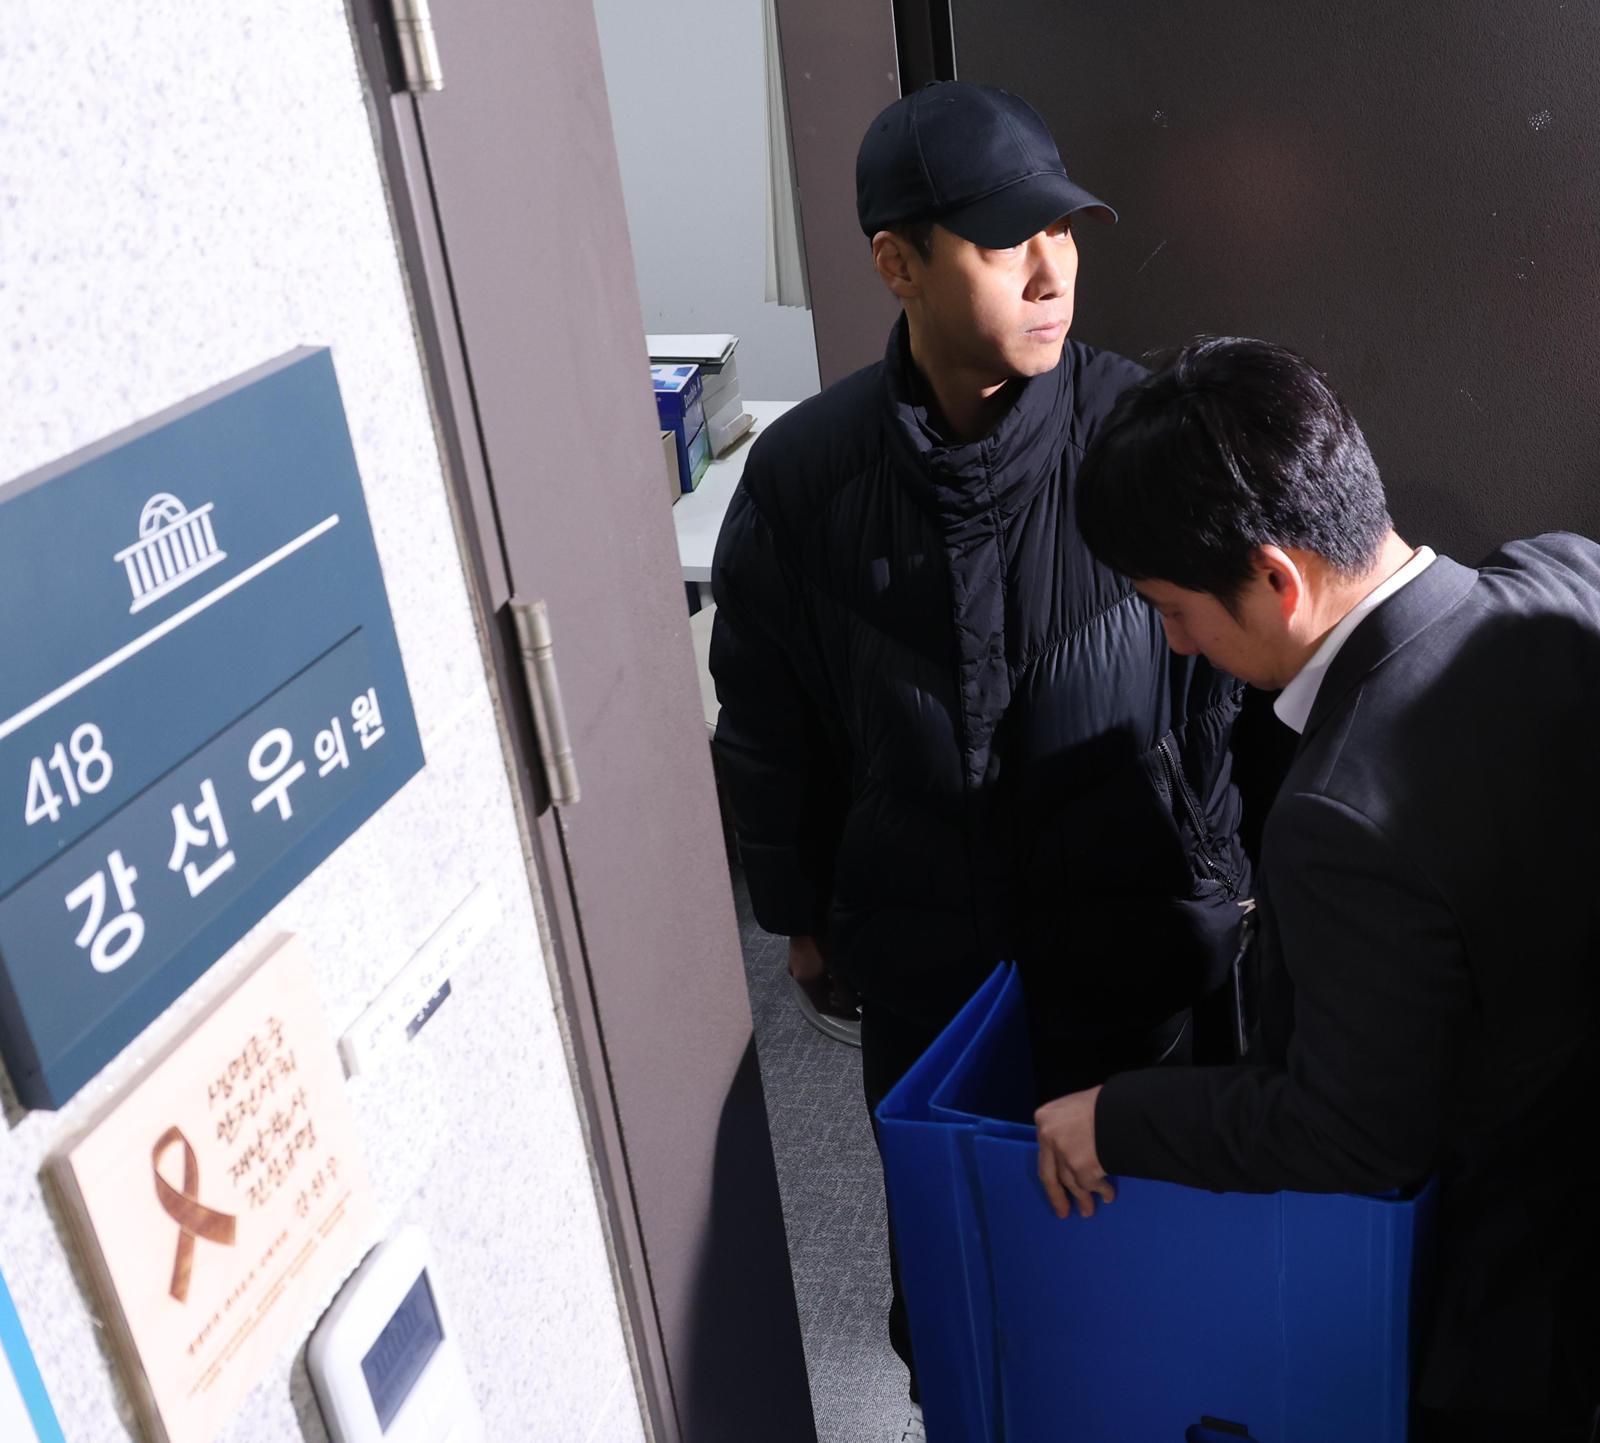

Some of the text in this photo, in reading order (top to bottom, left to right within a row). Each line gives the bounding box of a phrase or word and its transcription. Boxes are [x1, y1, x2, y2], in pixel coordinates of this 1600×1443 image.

[24, 722, 114, 826] 418
[313, 686, 386, 779] 의원
[216, 1048, 298, 1146] 안전사회
